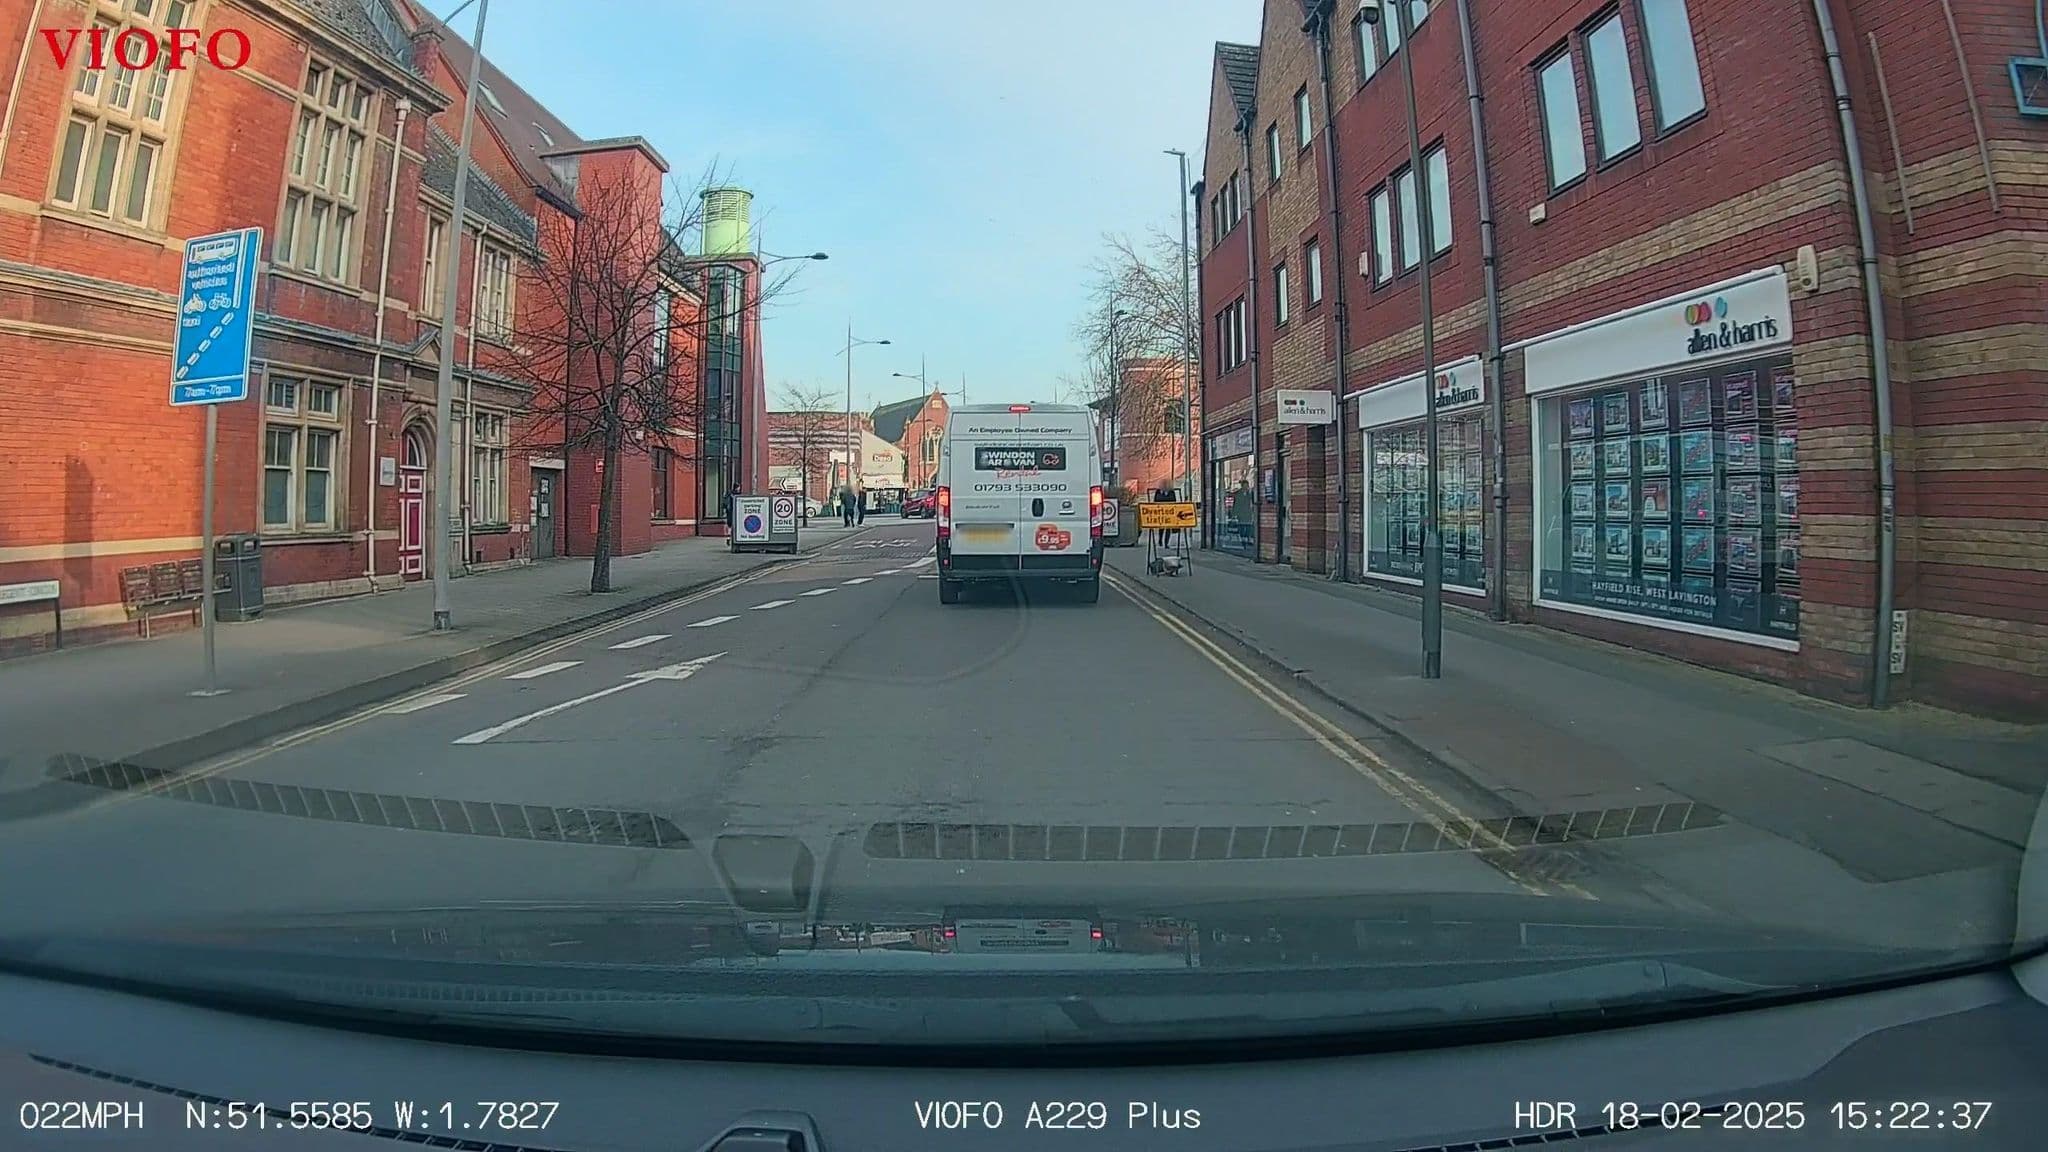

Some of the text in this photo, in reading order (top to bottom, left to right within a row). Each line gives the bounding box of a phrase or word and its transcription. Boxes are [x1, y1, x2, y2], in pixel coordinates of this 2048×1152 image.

[1686, 315, 1778, 355] allen & harris
[1012, 459, 1036, 467] VAN
[974, 483, 1067, 492] 01793 533090
[776, 503, 791, 513] 20
[1142, 505, 1175, 516] Diverted
[1146, 515, 1171, 525] traffic
[1591, 581, 1625, 594] HAYFIELD
[1646, 587, 1666, 600] WEST
[1668, 590, 1718, 607] LAVINGTON
